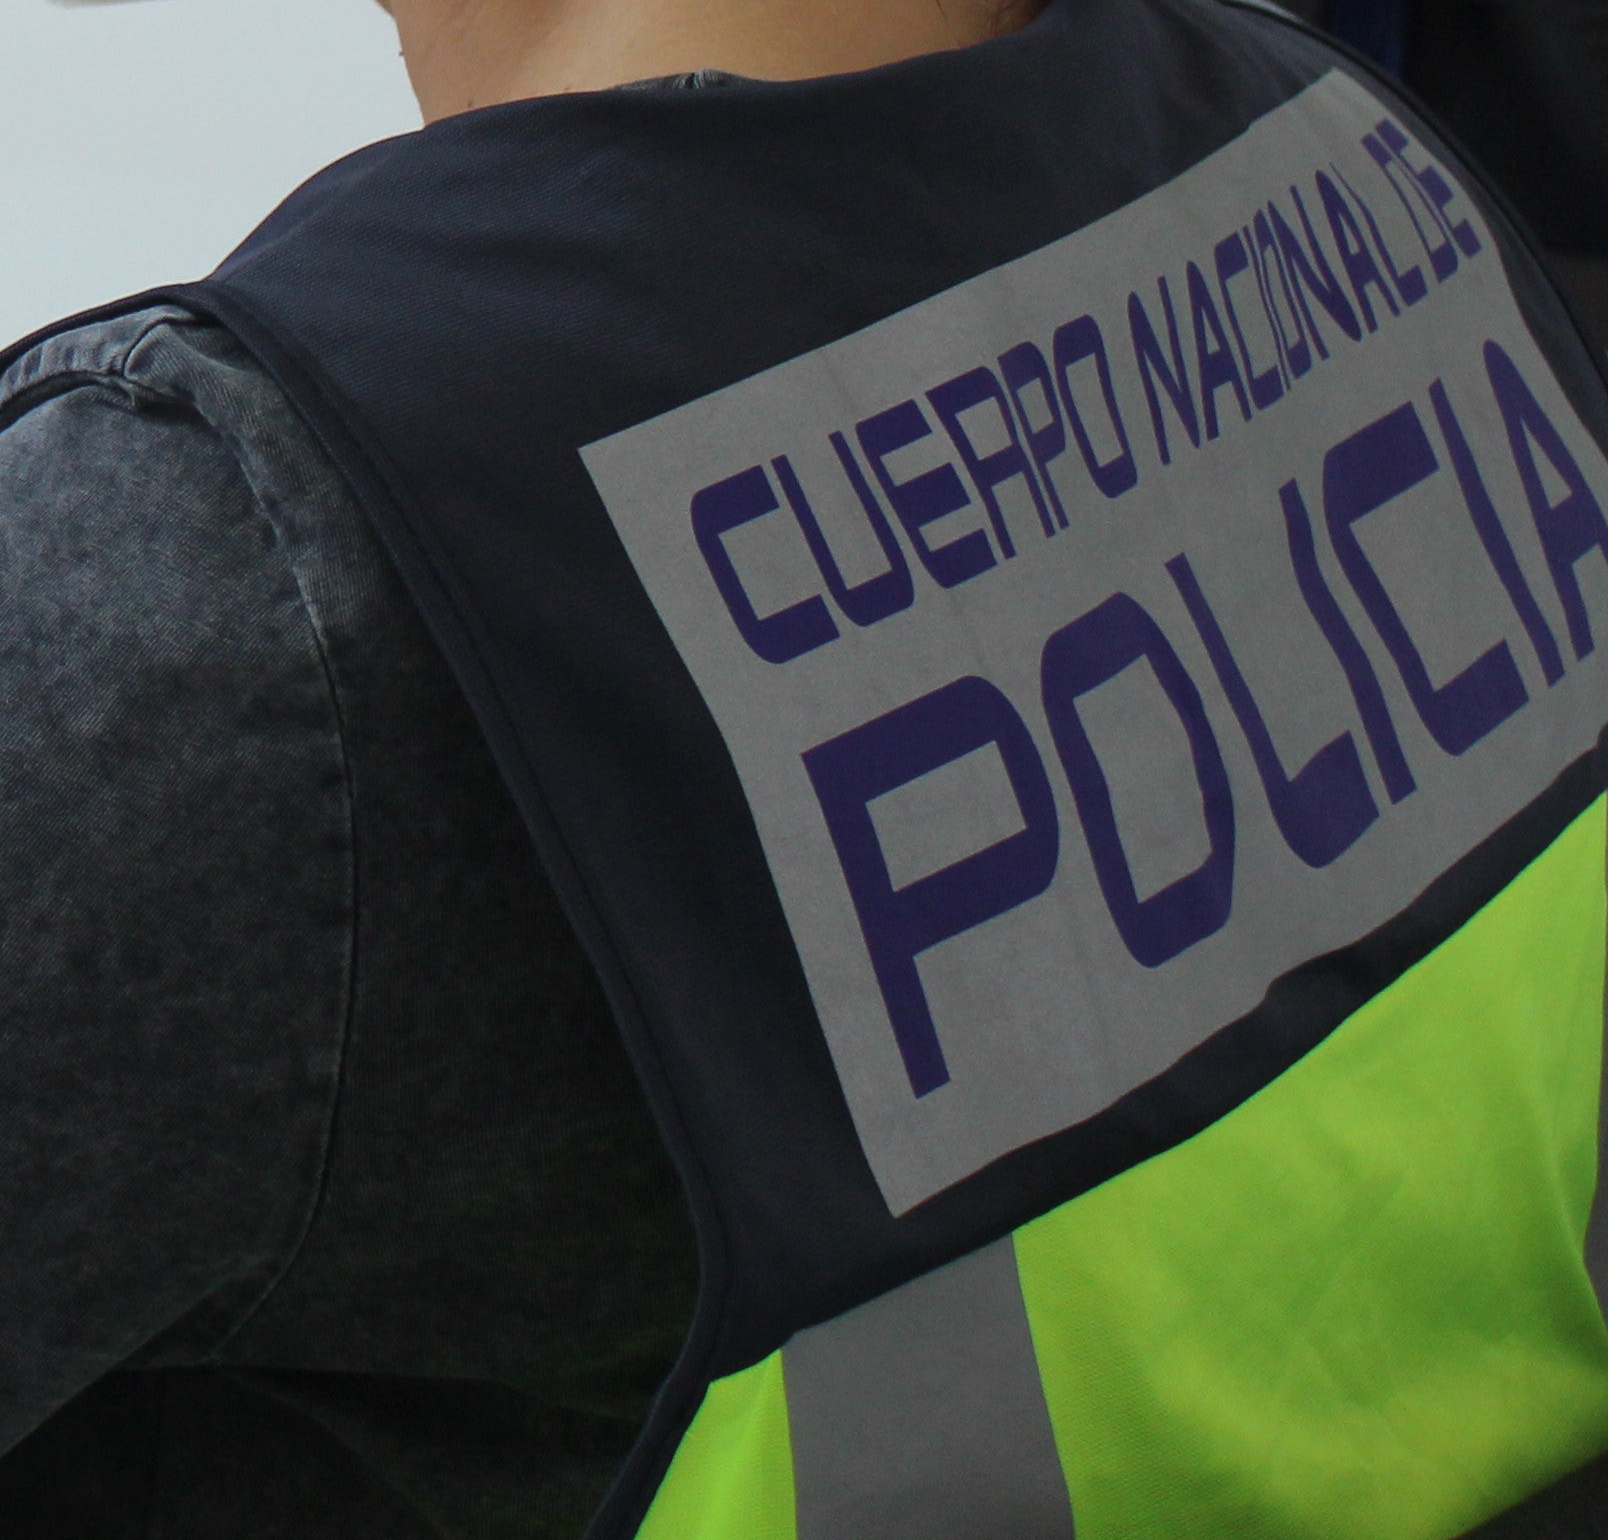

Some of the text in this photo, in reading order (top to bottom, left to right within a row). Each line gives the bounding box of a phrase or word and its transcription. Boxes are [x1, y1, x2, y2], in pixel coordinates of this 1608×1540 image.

[689, 117, 1483, 665] CUERPO NACIONAL DE
[800, 339, 1608, 1100] POLICIA
